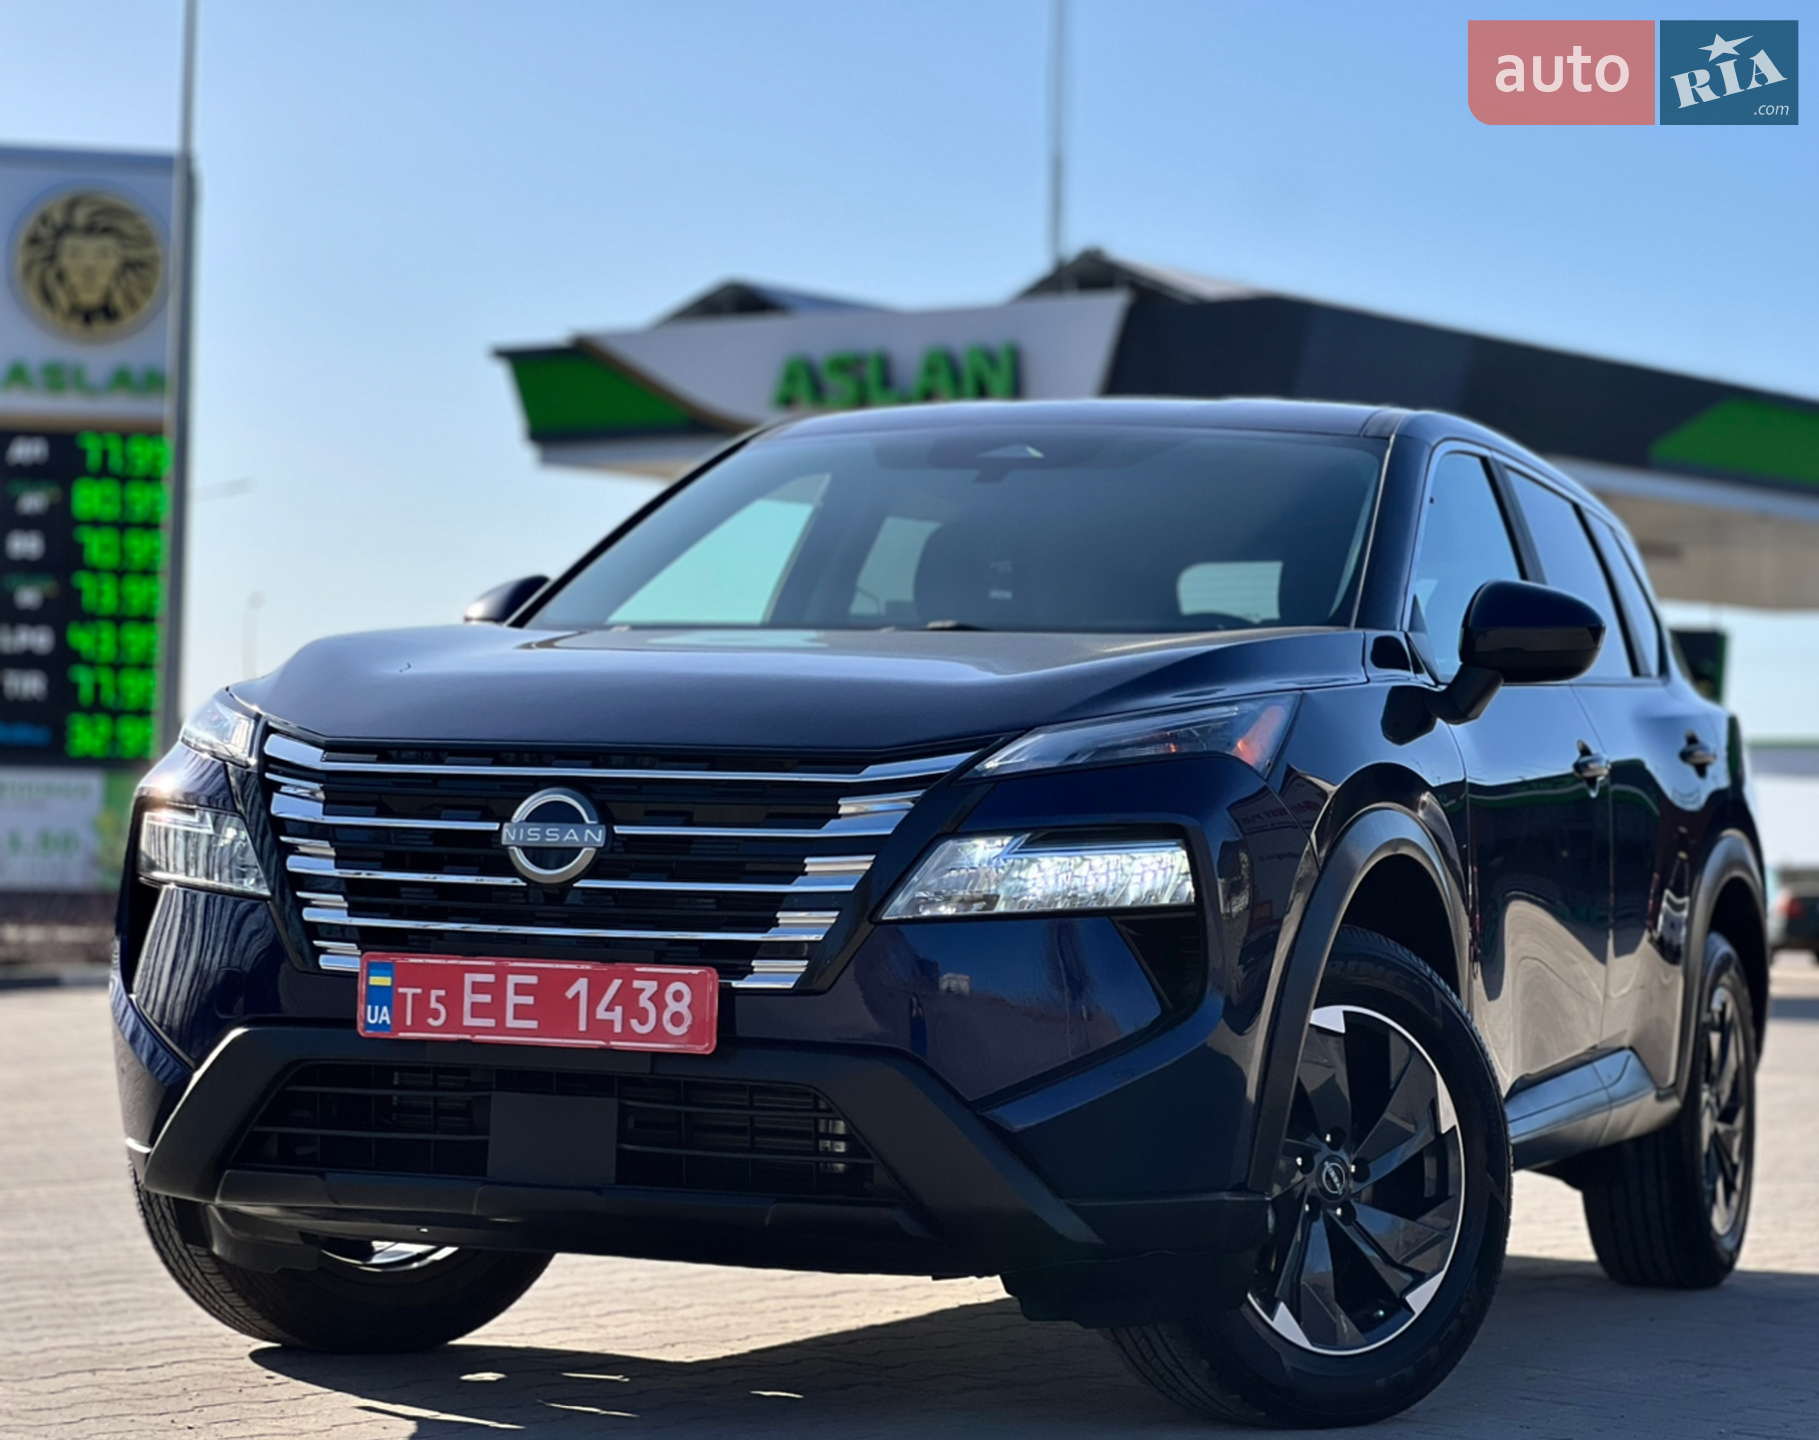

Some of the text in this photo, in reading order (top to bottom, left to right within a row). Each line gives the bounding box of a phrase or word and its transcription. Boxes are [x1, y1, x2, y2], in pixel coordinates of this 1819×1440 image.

[774, 344, 1018, 411] ASLAN
[505, 827, 602, 842] NISSAN
[367, 1005, 391, 1025] UA
[463, 973, 539, 1029] EE
[565, 978, 693, 1036] 1438
